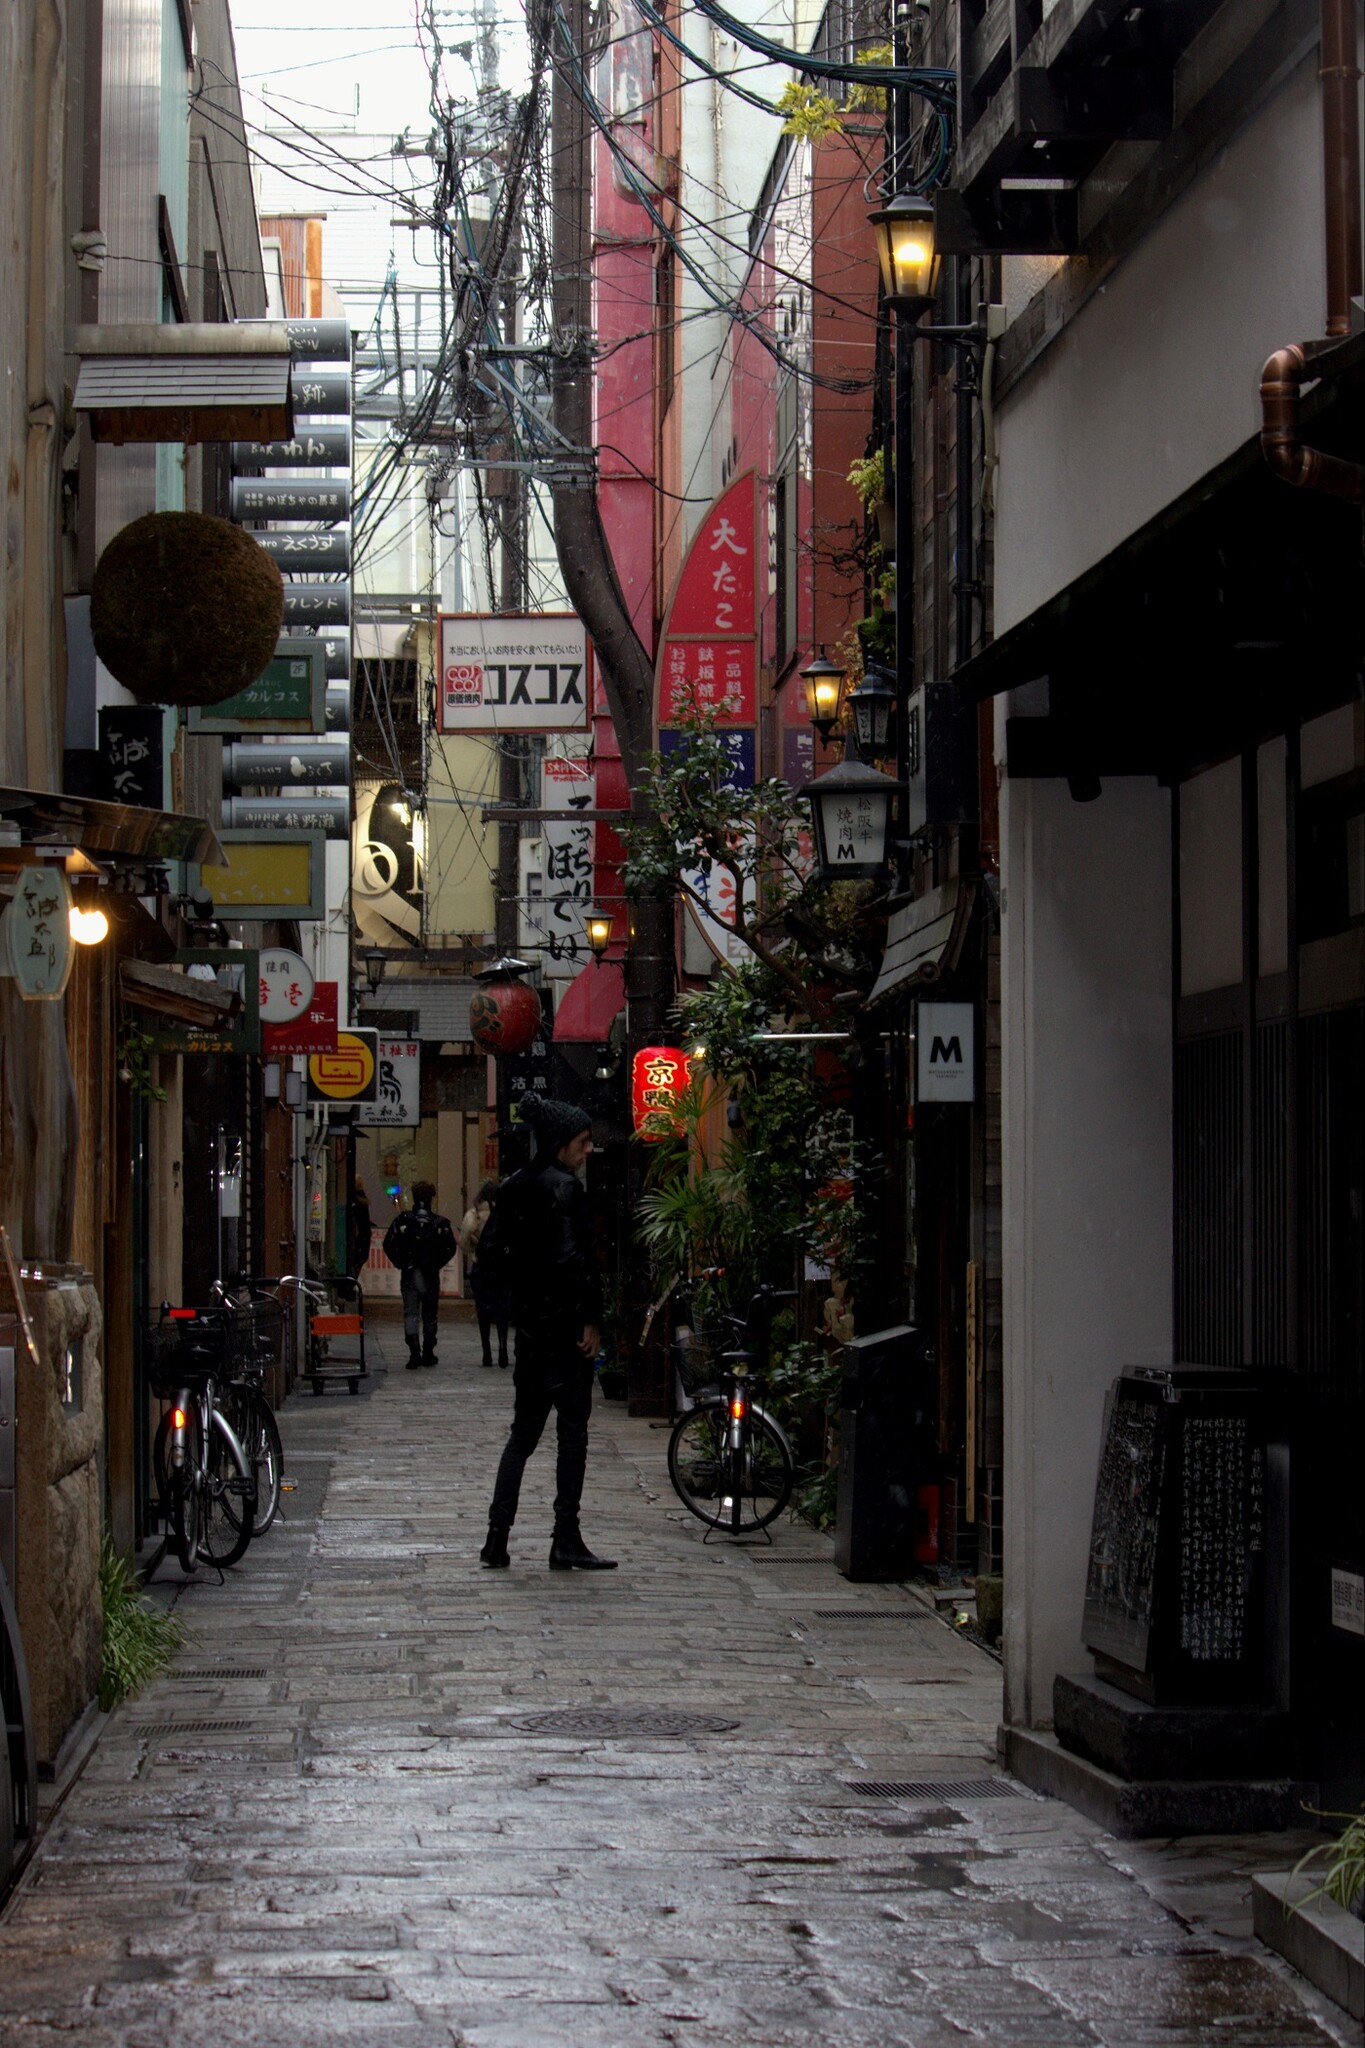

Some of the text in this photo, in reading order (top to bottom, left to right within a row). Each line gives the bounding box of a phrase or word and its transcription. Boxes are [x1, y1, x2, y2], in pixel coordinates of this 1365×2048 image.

[710, 518, 748, 629] 大たこ
[449, 644, 582, 656] 本当においしいお肉を安く食べてもらいたい
[484, 664, 584, 705] コスコス
[725, 649, 742, 714] 一品料理
[245, 690, 300, 703] カルコス
[447, 693, 481, 705] 原価焼肉
[284, 812, 336, 830] 熊野灘
[837, 807, 854, 841] 焼肉
[858, 797, 873, 846] 松阪牛
[837, 844, 855, 859] M
[547, 842, 577, 961] ほてい
[187, 1041, 235, 1054] カルコス
[930, 1036, 963, 1063] M
